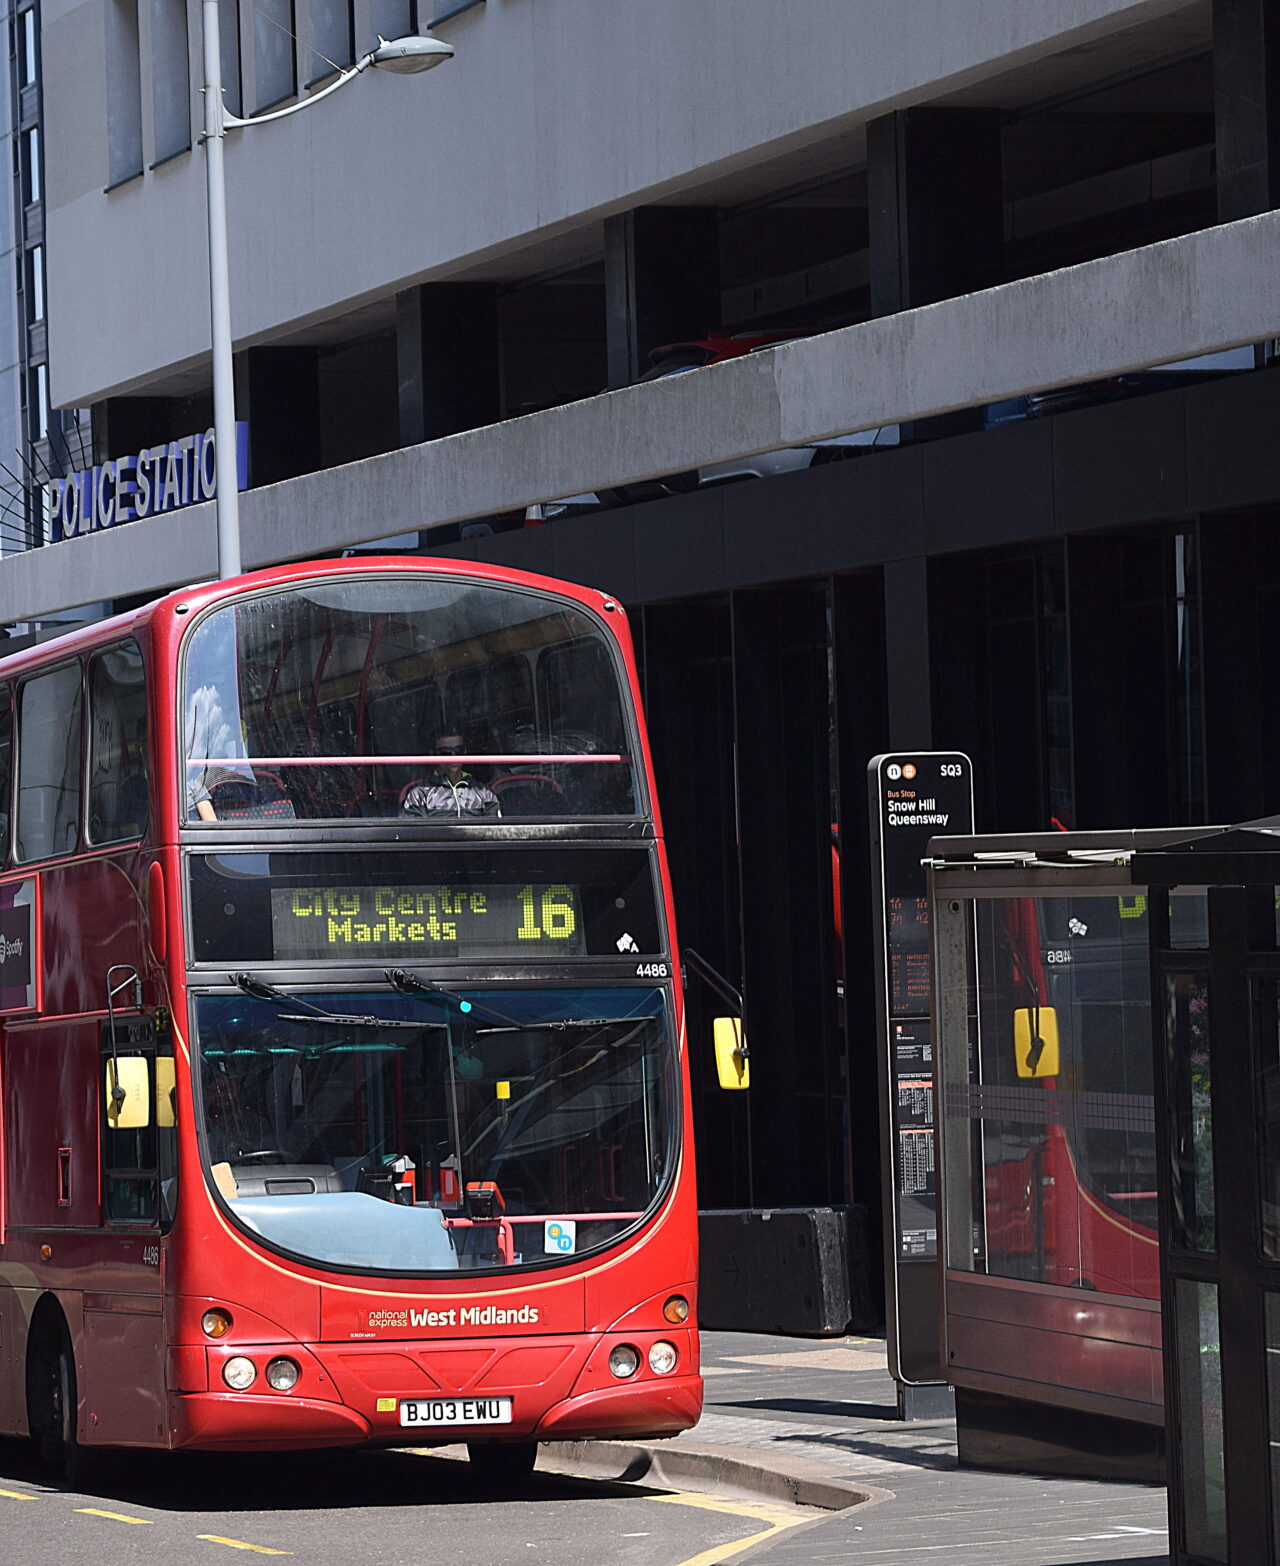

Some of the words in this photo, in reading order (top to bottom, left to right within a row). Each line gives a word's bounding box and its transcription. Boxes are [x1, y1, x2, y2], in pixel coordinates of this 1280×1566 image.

[48, 455, 135, 542] POLICE
[135, 427, 218, 518] STATIO
[940, 764, 962, 777] SQ3
[887, 790, 899, 798] Bus
[900, 790, 916, 798] Stop
[887, 800, 916, 812] Snow
[918, 798, 936, 811] Hill
[888, 813, 949, 827] Queensway
[291, 887, 360, 916] City
[375, 885, 488, 916] Centre
[517, 884, 576, 940] 16
[327, 915, 458, 943] Markets
[5, 938, 24, 957] Spotify
[635, 964, 668, 978] 4486
[143, 1245, 159, 1265] 4486
[368, 1309, 408, 1319] national
[409, 1307, 456, 1327] West
[460, 1305, 539, 1326] Midlands
[368, 1318, 408, 1329] express
[407, 1402, 457, 1422] BJ03
[463, 1400, 501, 1420] EWU
